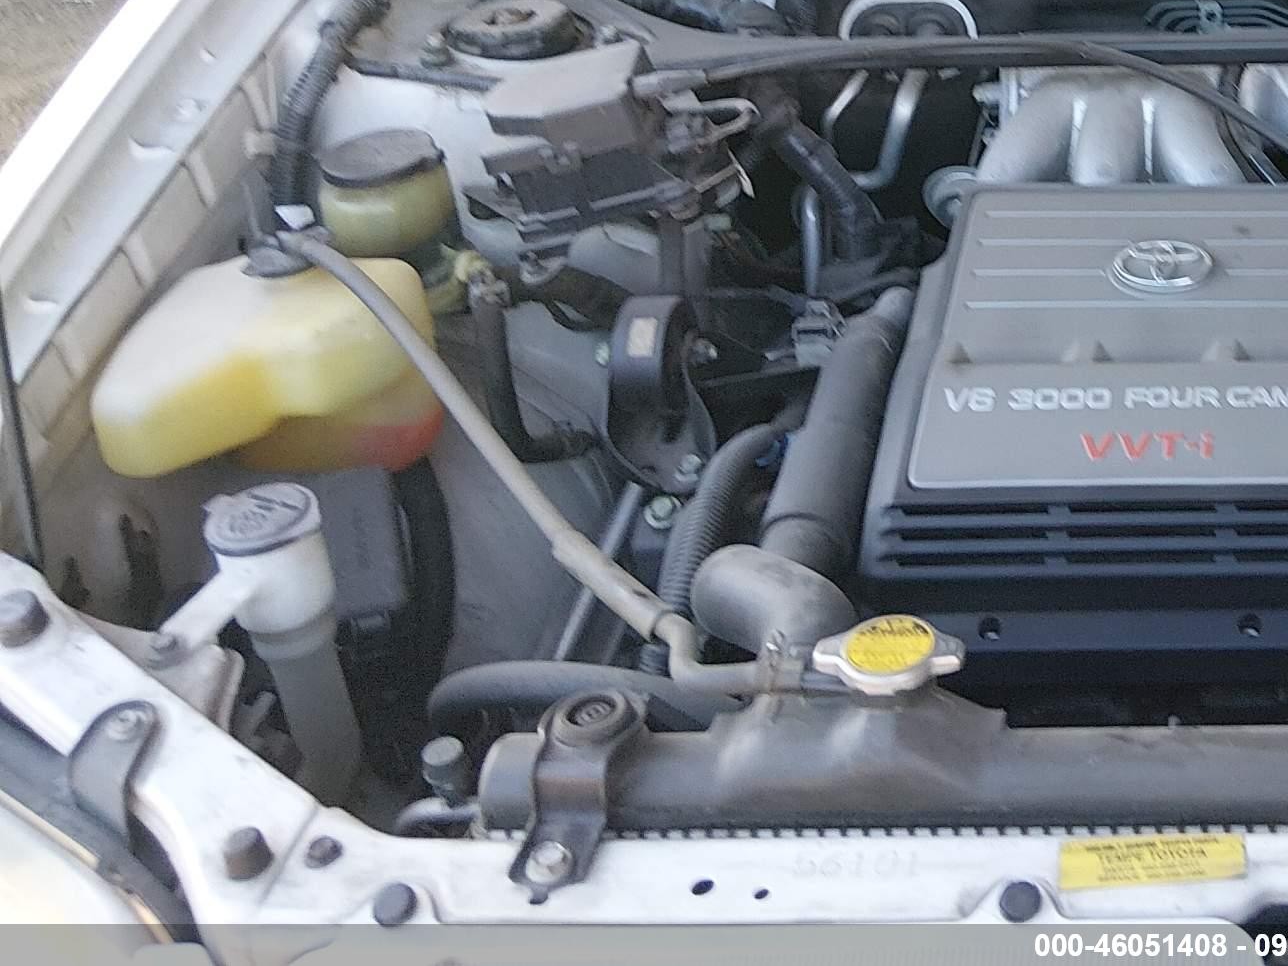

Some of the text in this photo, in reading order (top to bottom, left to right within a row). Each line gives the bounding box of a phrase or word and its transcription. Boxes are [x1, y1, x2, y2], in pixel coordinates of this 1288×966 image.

[943, 386, 996, 412] V6
[1007, 386, 1112, 411] 3000
[1124, 386, 1223, 410] FOUR
[1080, 430, 1216, 464] VVT-i
